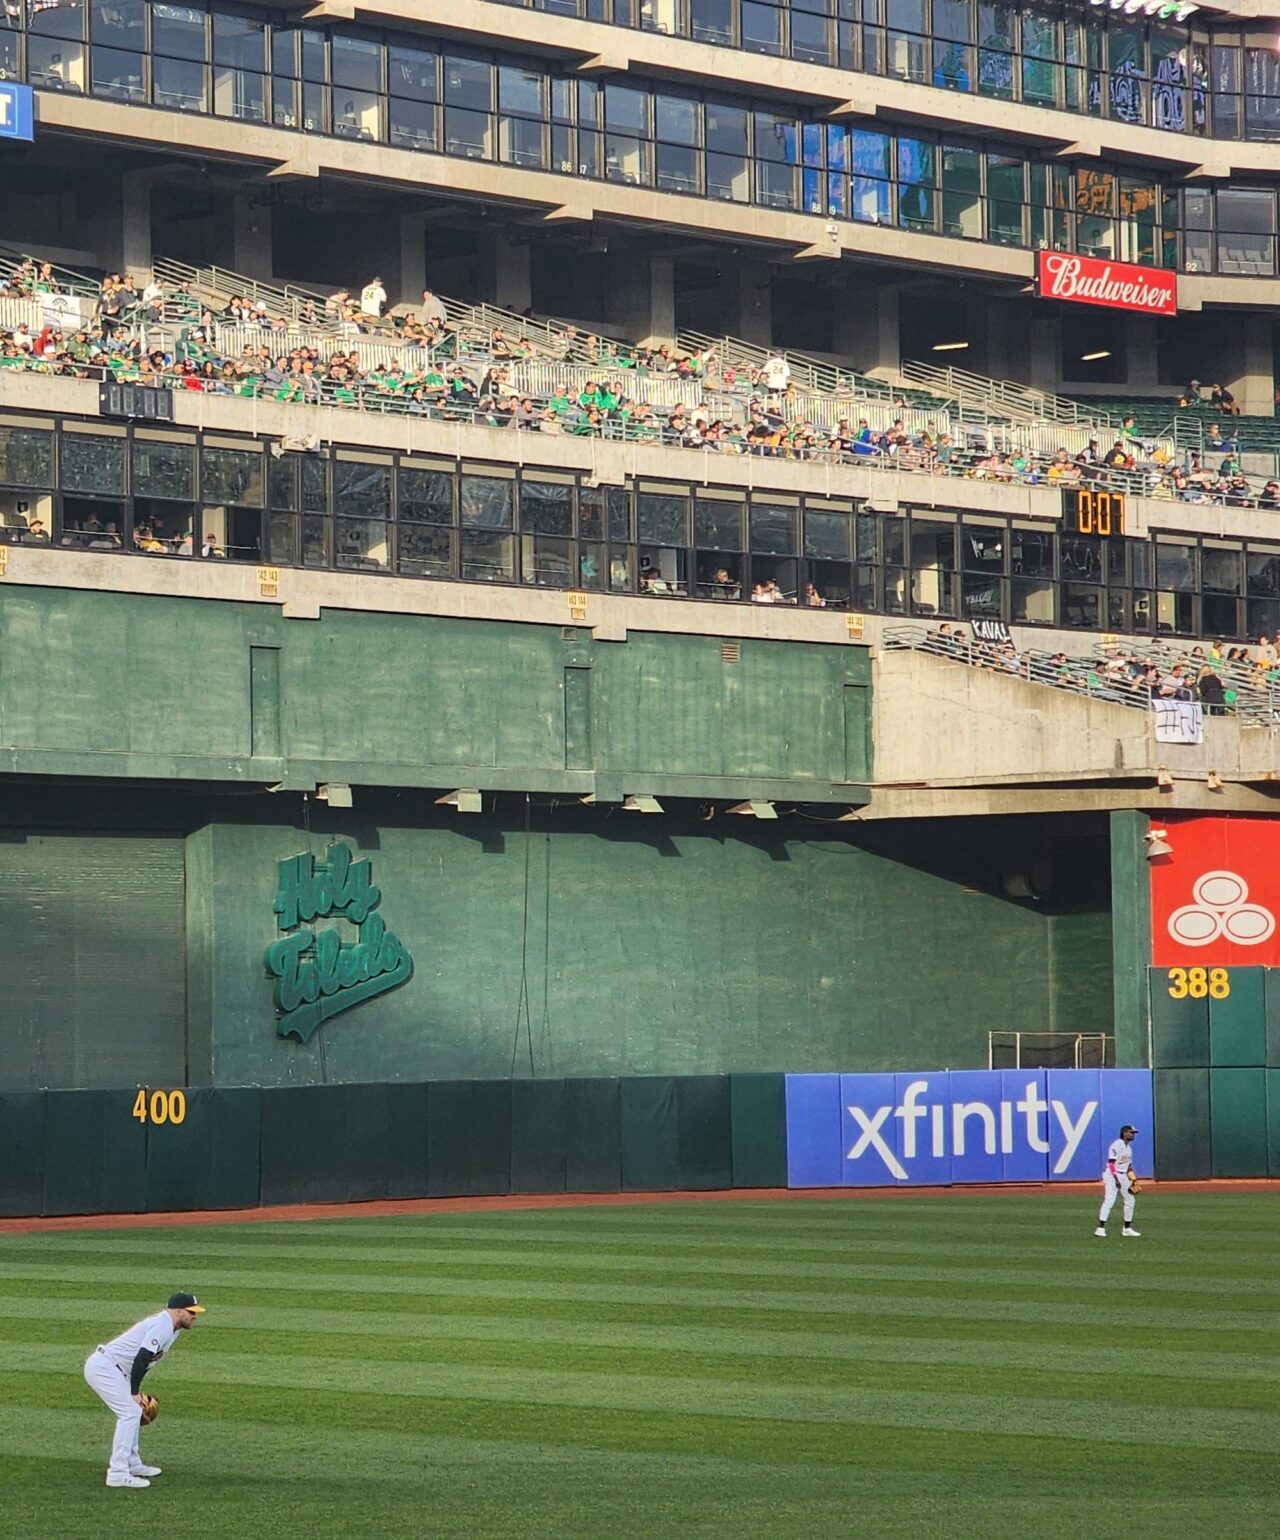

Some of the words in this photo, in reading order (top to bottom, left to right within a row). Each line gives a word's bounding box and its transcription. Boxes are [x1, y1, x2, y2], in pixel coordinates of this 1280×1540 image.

[365, 291, 374, 300] 24
[1046, 256, 1171, 308] Budweiser
[773, 366, 783, 375] 24
[1079, 491, 1124, 536] 0:07
[257, 569, 267, 581] 142
[269, 570, 278, 582] 143
[273, 843, 381, 930] Holy
[1168, 967, 1230, 999] 388
[133, 1090, 186, 1124] 400
[847, 1081, 1098, 1179] xfinity
